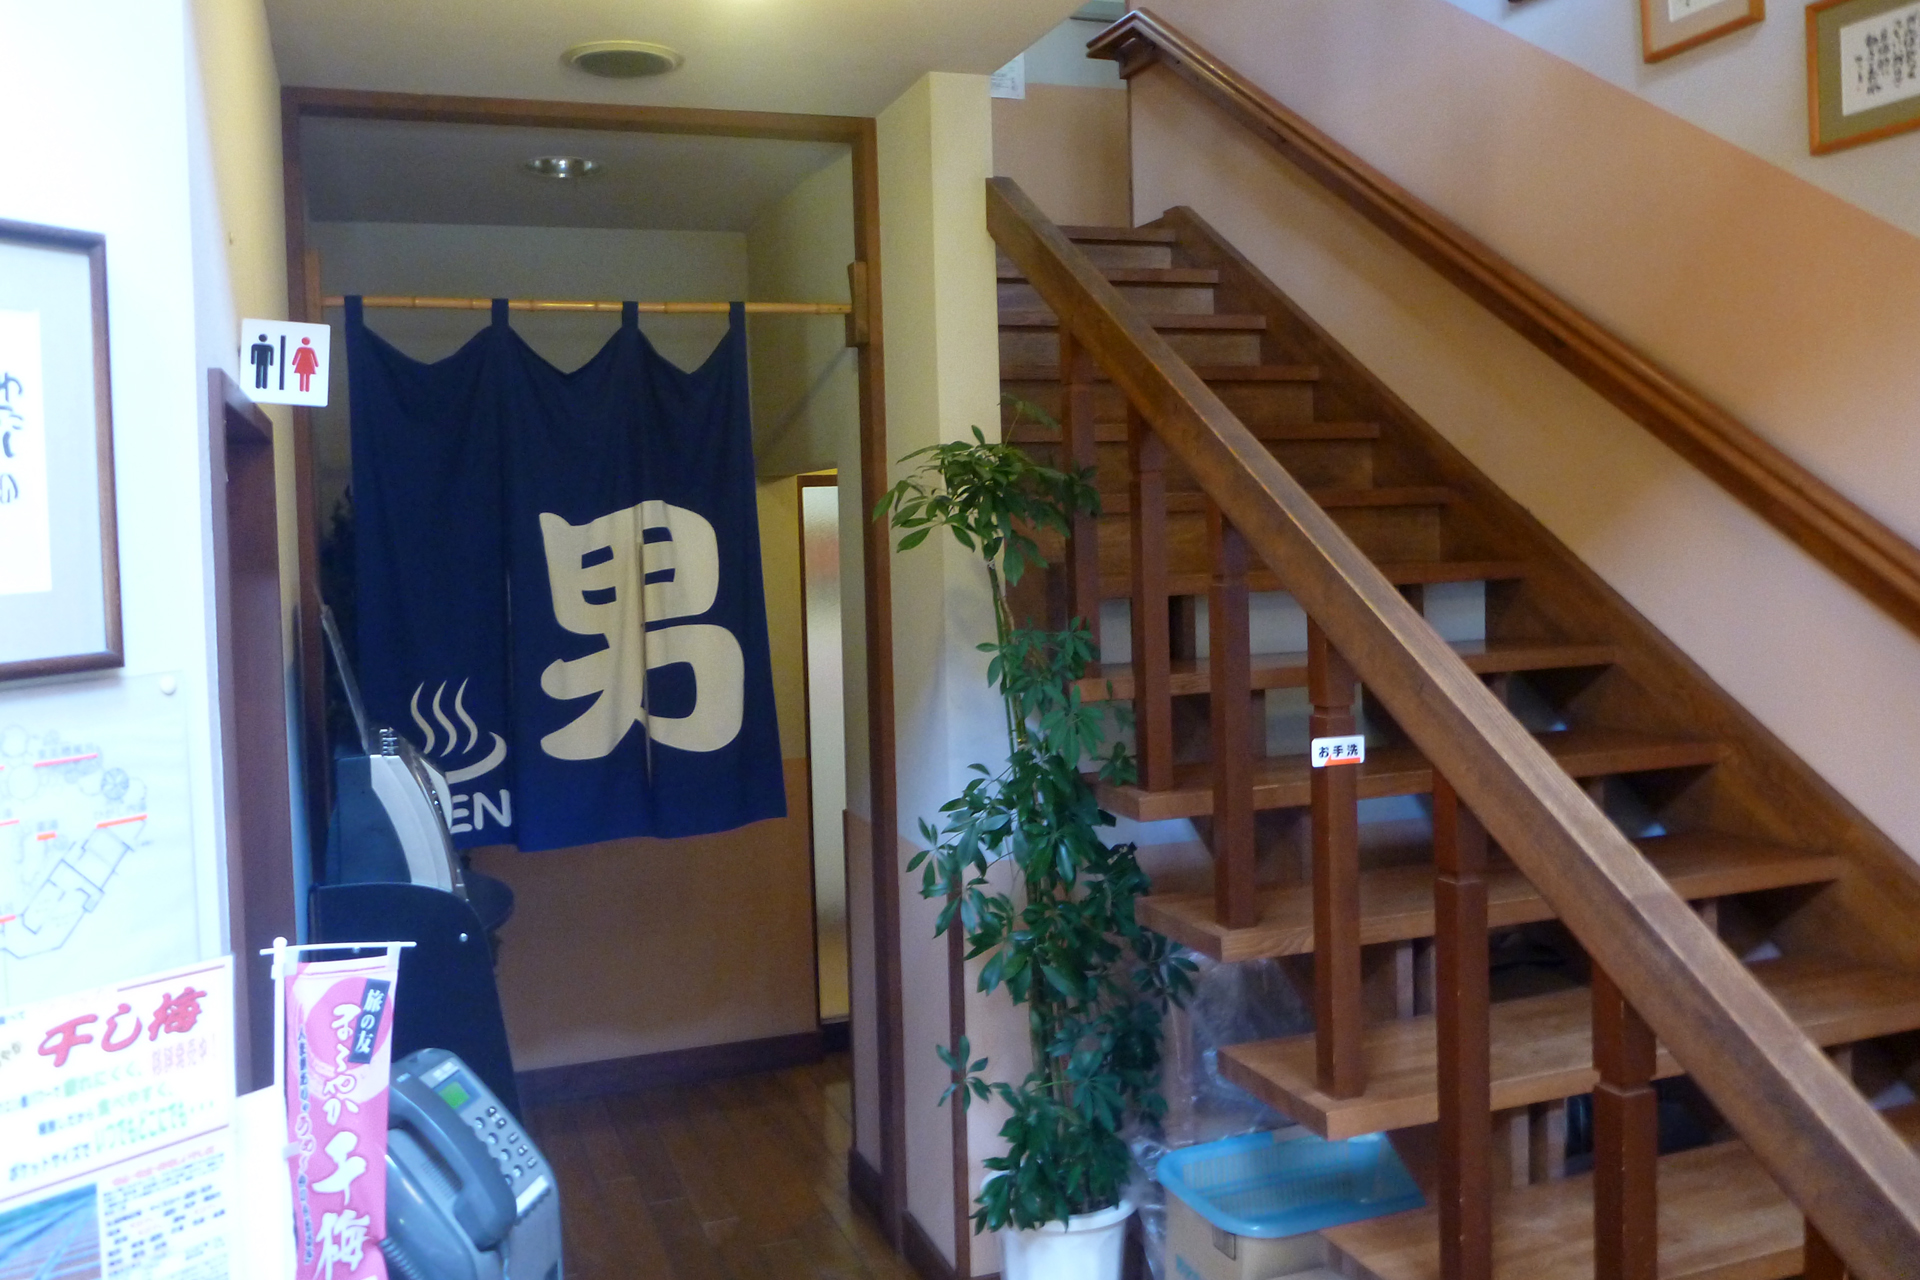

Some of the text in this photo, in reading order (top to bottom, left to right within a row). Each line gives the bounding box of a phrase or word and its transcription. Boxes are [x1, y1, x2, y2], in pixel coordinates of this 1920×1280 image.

[539, 500, 744, 760] 男
[1318, 743, 1358, 758] お手洗
[450, 789, 512, 833] EN
[37, 986, 208, 1067] 干し梅
[354, 989, 385, 1054] 旅の友
